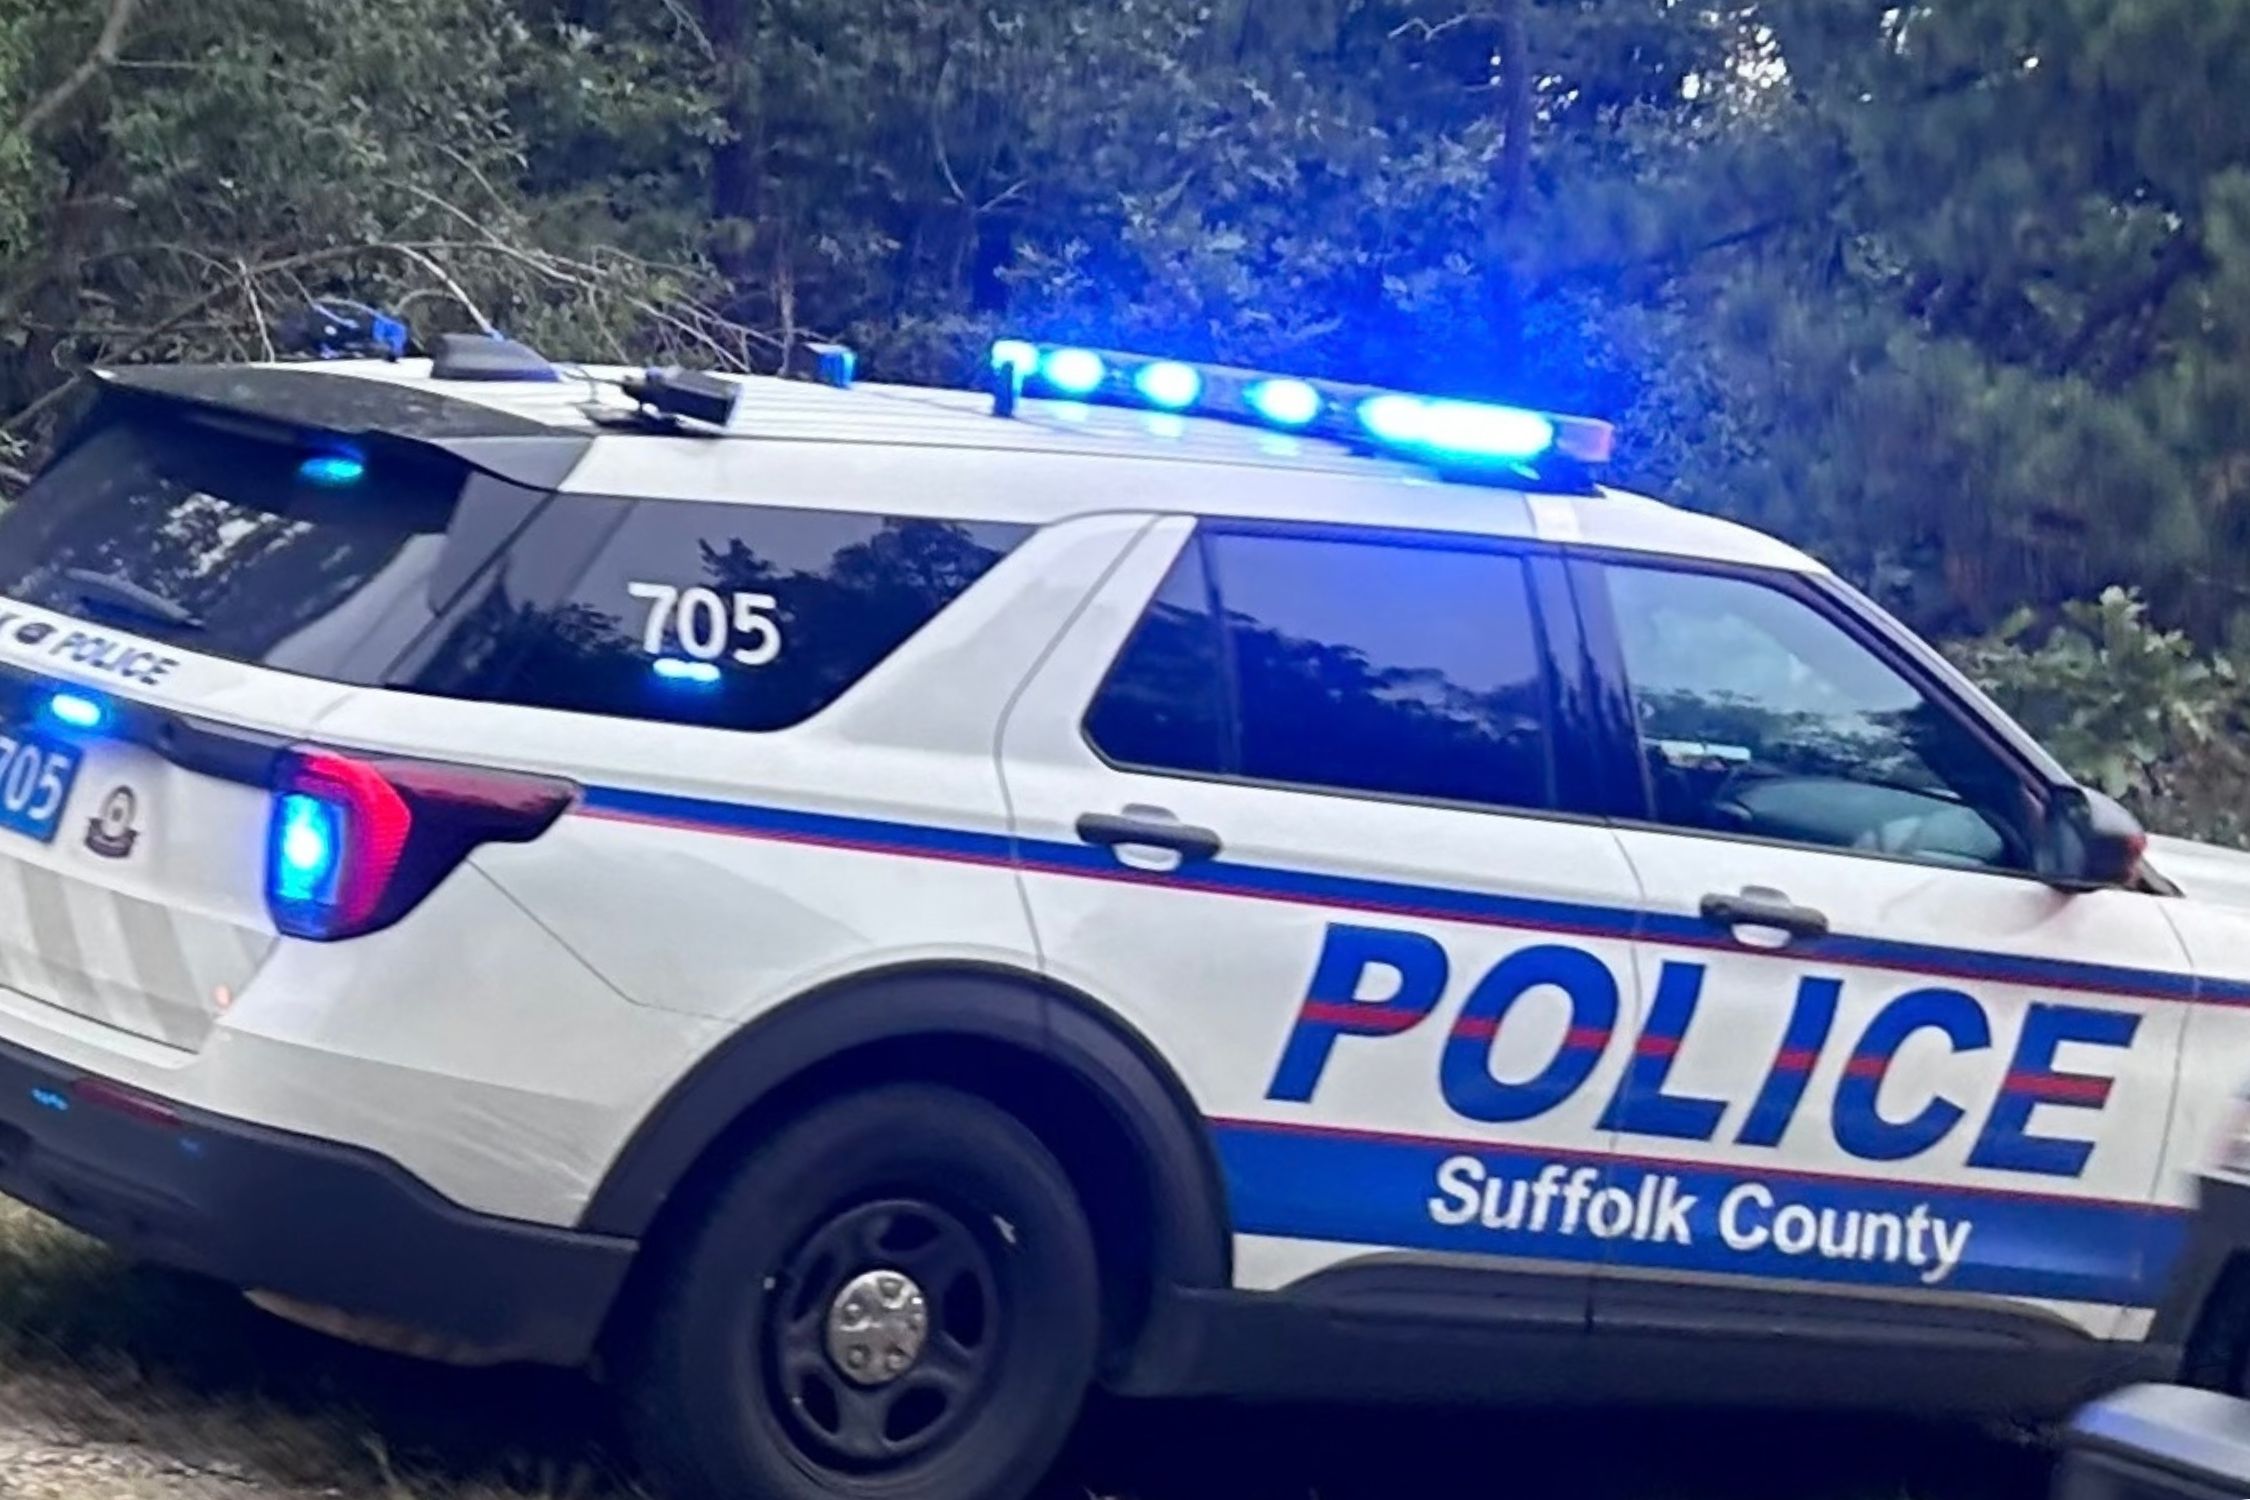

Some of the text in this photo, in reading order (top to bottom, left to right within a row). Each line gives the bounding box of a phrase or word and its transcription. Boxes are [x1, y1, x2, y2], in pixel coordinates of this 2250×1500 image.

[49, 631, 179, 685] POLICE
[627, 581, 782, 666] 705
[1265, 922, 2142, 1178] POLICE
[1429, 1156, 1972, 1283] Suffolk County
